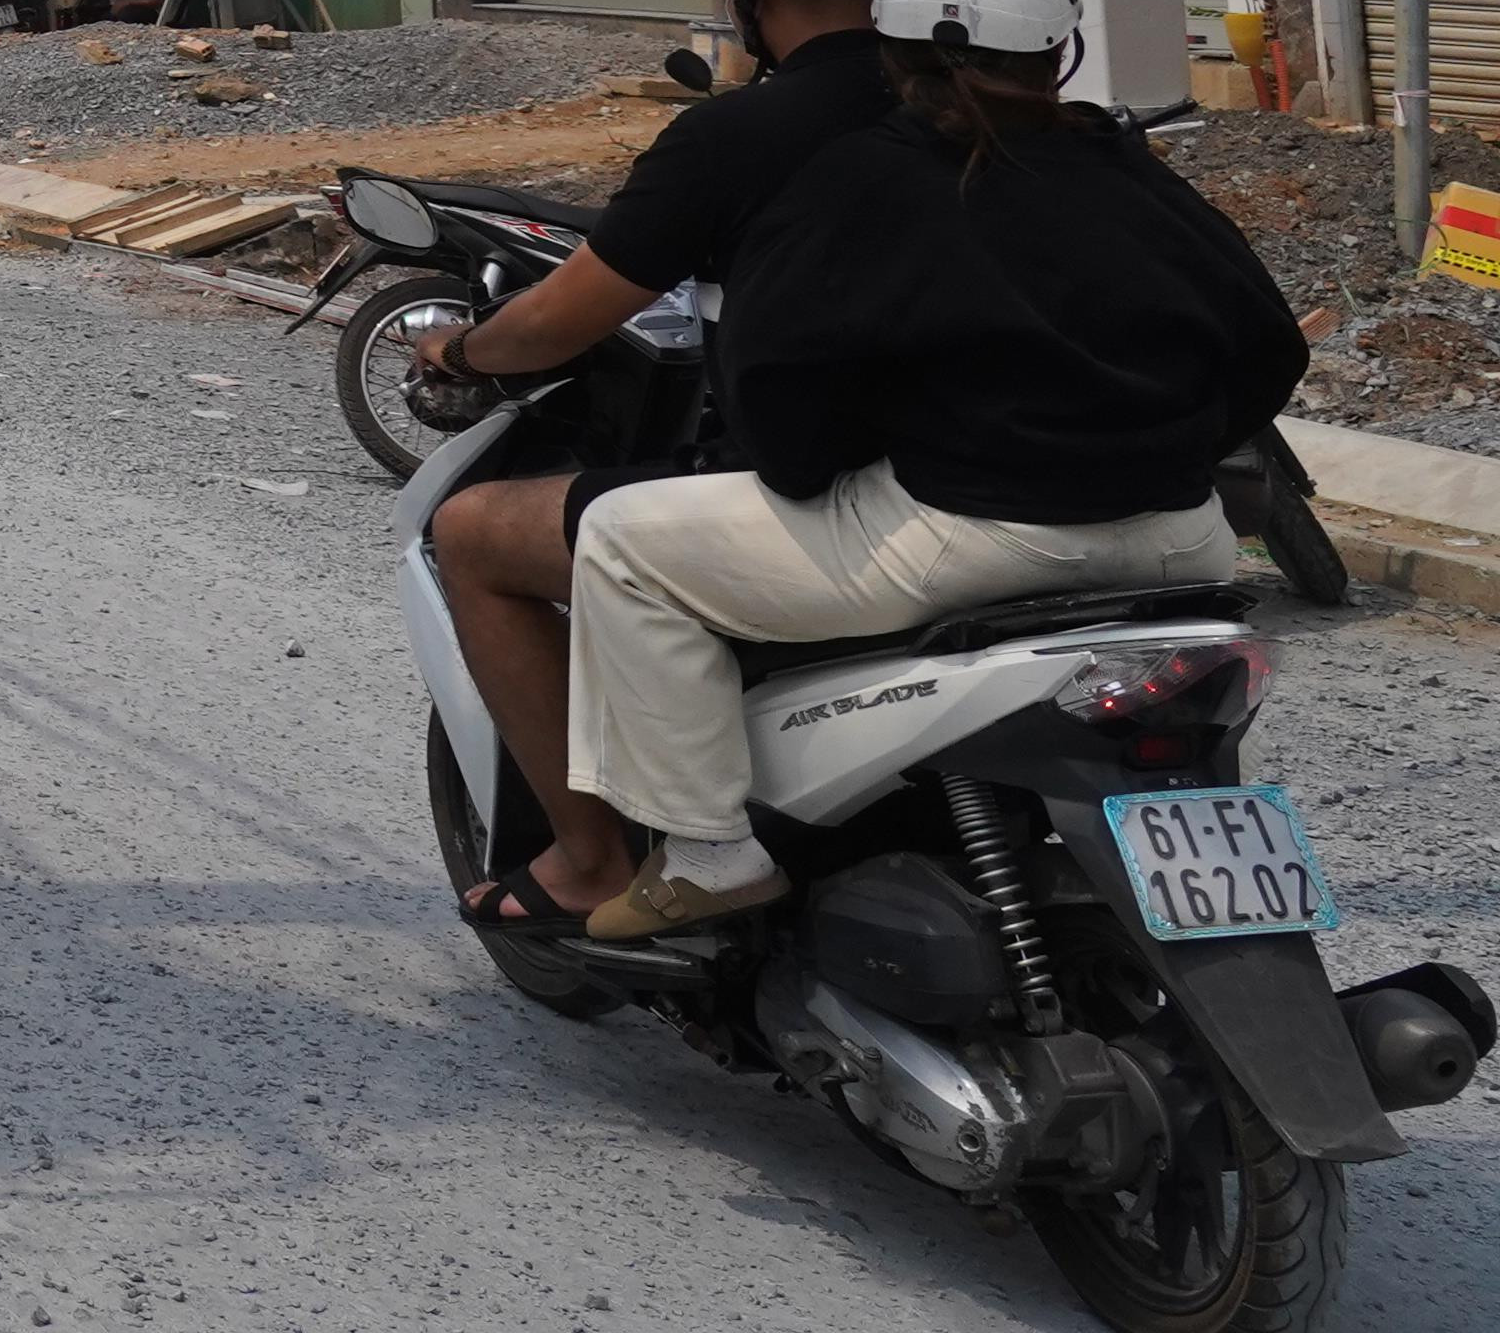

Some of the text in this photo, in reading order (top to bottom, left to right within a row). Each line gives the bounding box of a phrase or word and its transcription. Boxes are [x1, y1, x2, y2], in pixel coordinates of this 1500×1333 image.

[780, 679, 938, 731] AIR BLADE
[1140, 799, 1276, 861] 61-F1
[1150, 862, 1318, 929] 162.02
